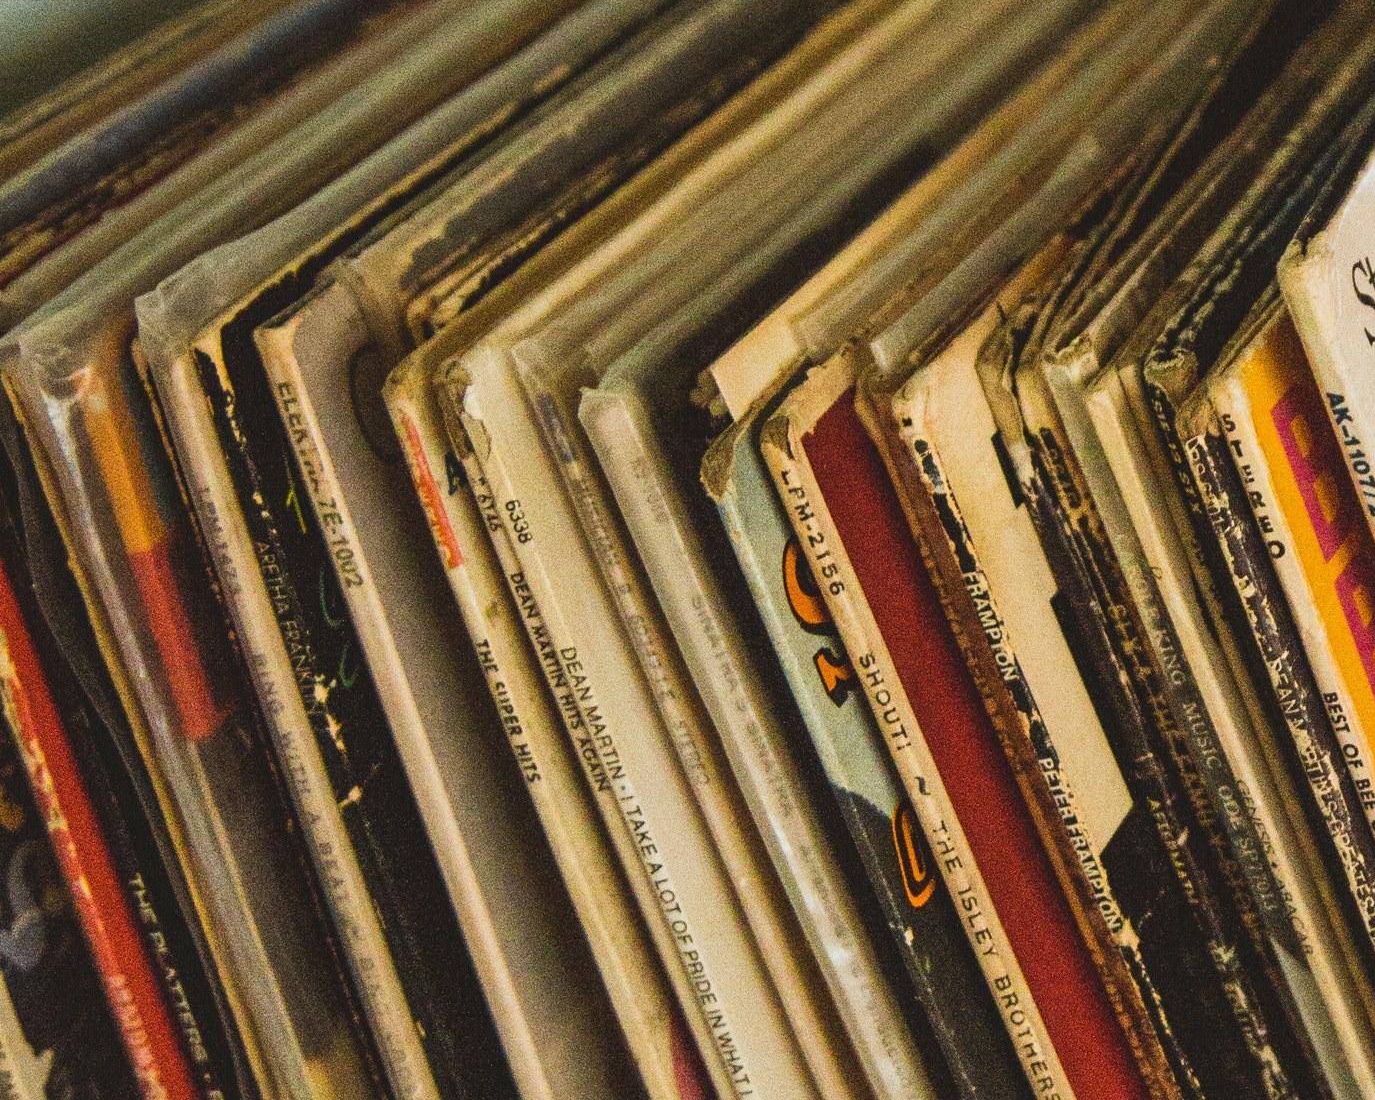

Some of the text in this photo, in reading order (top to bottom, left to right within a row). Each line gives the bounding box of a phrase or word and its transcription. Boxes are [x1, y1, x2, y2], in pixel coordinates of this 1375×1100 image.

[317, 497, 365, 589] 7E-1002
[503, 498, 535, 544] 6338
[255, 539, 292, 614] ARETHA
[1220, 413, 1286, 560] STEREO
[1324, 691, 1349, 735] BEST
[1343, 742, 1362, 770] OF
[475, 639, 541, 783] THE SUPER HITS
[511, 572, 539, 619] DEAN
[531, 624, 569, 688] MARTIN
[561, 693, 585, 730] HITS
[578, 736, 611, 793] AGAIN
[560, 645, 595, 702] DEAN
[583, 704, 626, 781] MARTIN
[962, 570, 1123, 929] FRAMPTON PETER FRAMPTON
[1151, 627, 1187, 687] KING
[1182, 701, 1222, 771] MUSIC
[1217, 784, 1246, 830] ODE
[624, 807, 656, 856] TAKE
[857, 652, 913, 751] SHOUT!
[929, 821, 965, 874] THE
[955, 885, 1001, 960] ISLEY
[645, 858, 664, 876] A
[1148, 796, 1202, 905] AFTERMATH
[652, 877, 681, 918] LOT
[669, 919, 694, 949] OF
[128, 873, 157, 924] THE
[149, 930, 208, 1061] PLATTERS
[681, 949, 718, 1006] PRIDE
[705, 1008, 727, 1030] IN
[714, 1031, 748, 1084] WHAT
